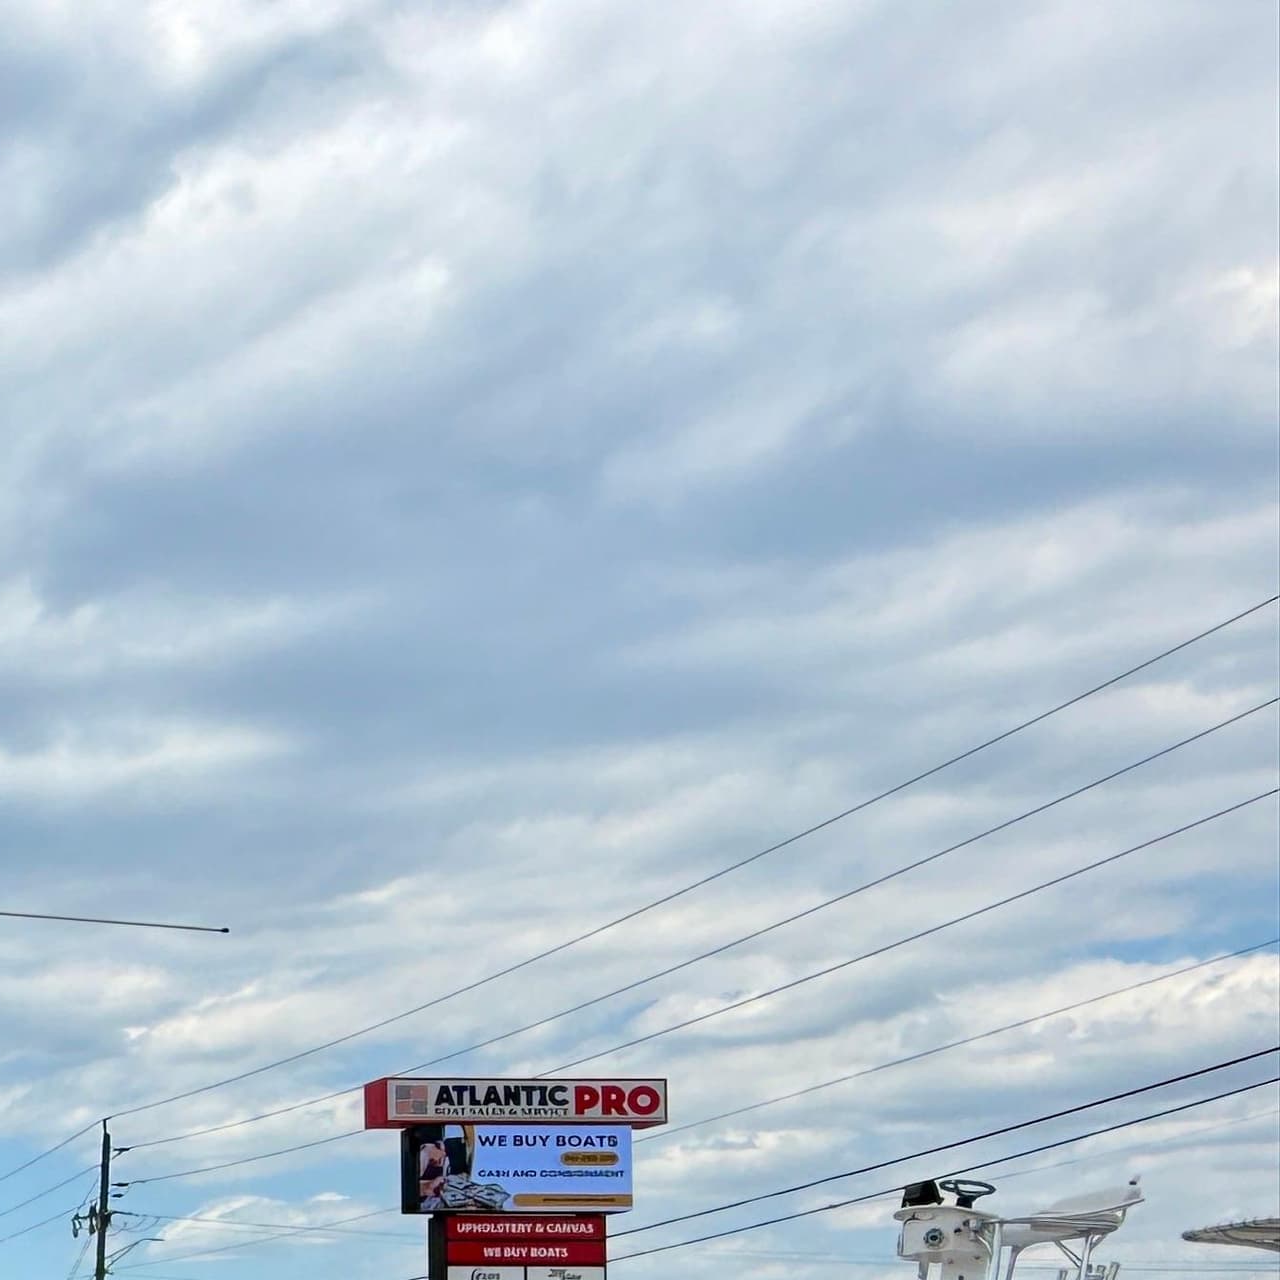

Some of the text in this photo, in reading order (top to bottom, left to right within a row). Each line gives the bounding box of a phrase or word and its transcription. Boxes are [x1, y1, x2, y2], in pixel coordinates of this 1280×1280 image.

[434, 1084, 661, 1117] ATLANTIC PRO
[434, 1106, 466, 1117] BOAT
[468, 1106, 506, 1117] SALES
[520, 1106, 570, 1117] SERVICE
[477, 1134, 619, 1148] WE BUY BOATS
[512, 1168, 538, 1179] AND
[456, 1222, 595, 1234] UPHOLSTERY & CANVAS
[483, 1246, 569, 1259] WE BUY BOATS
